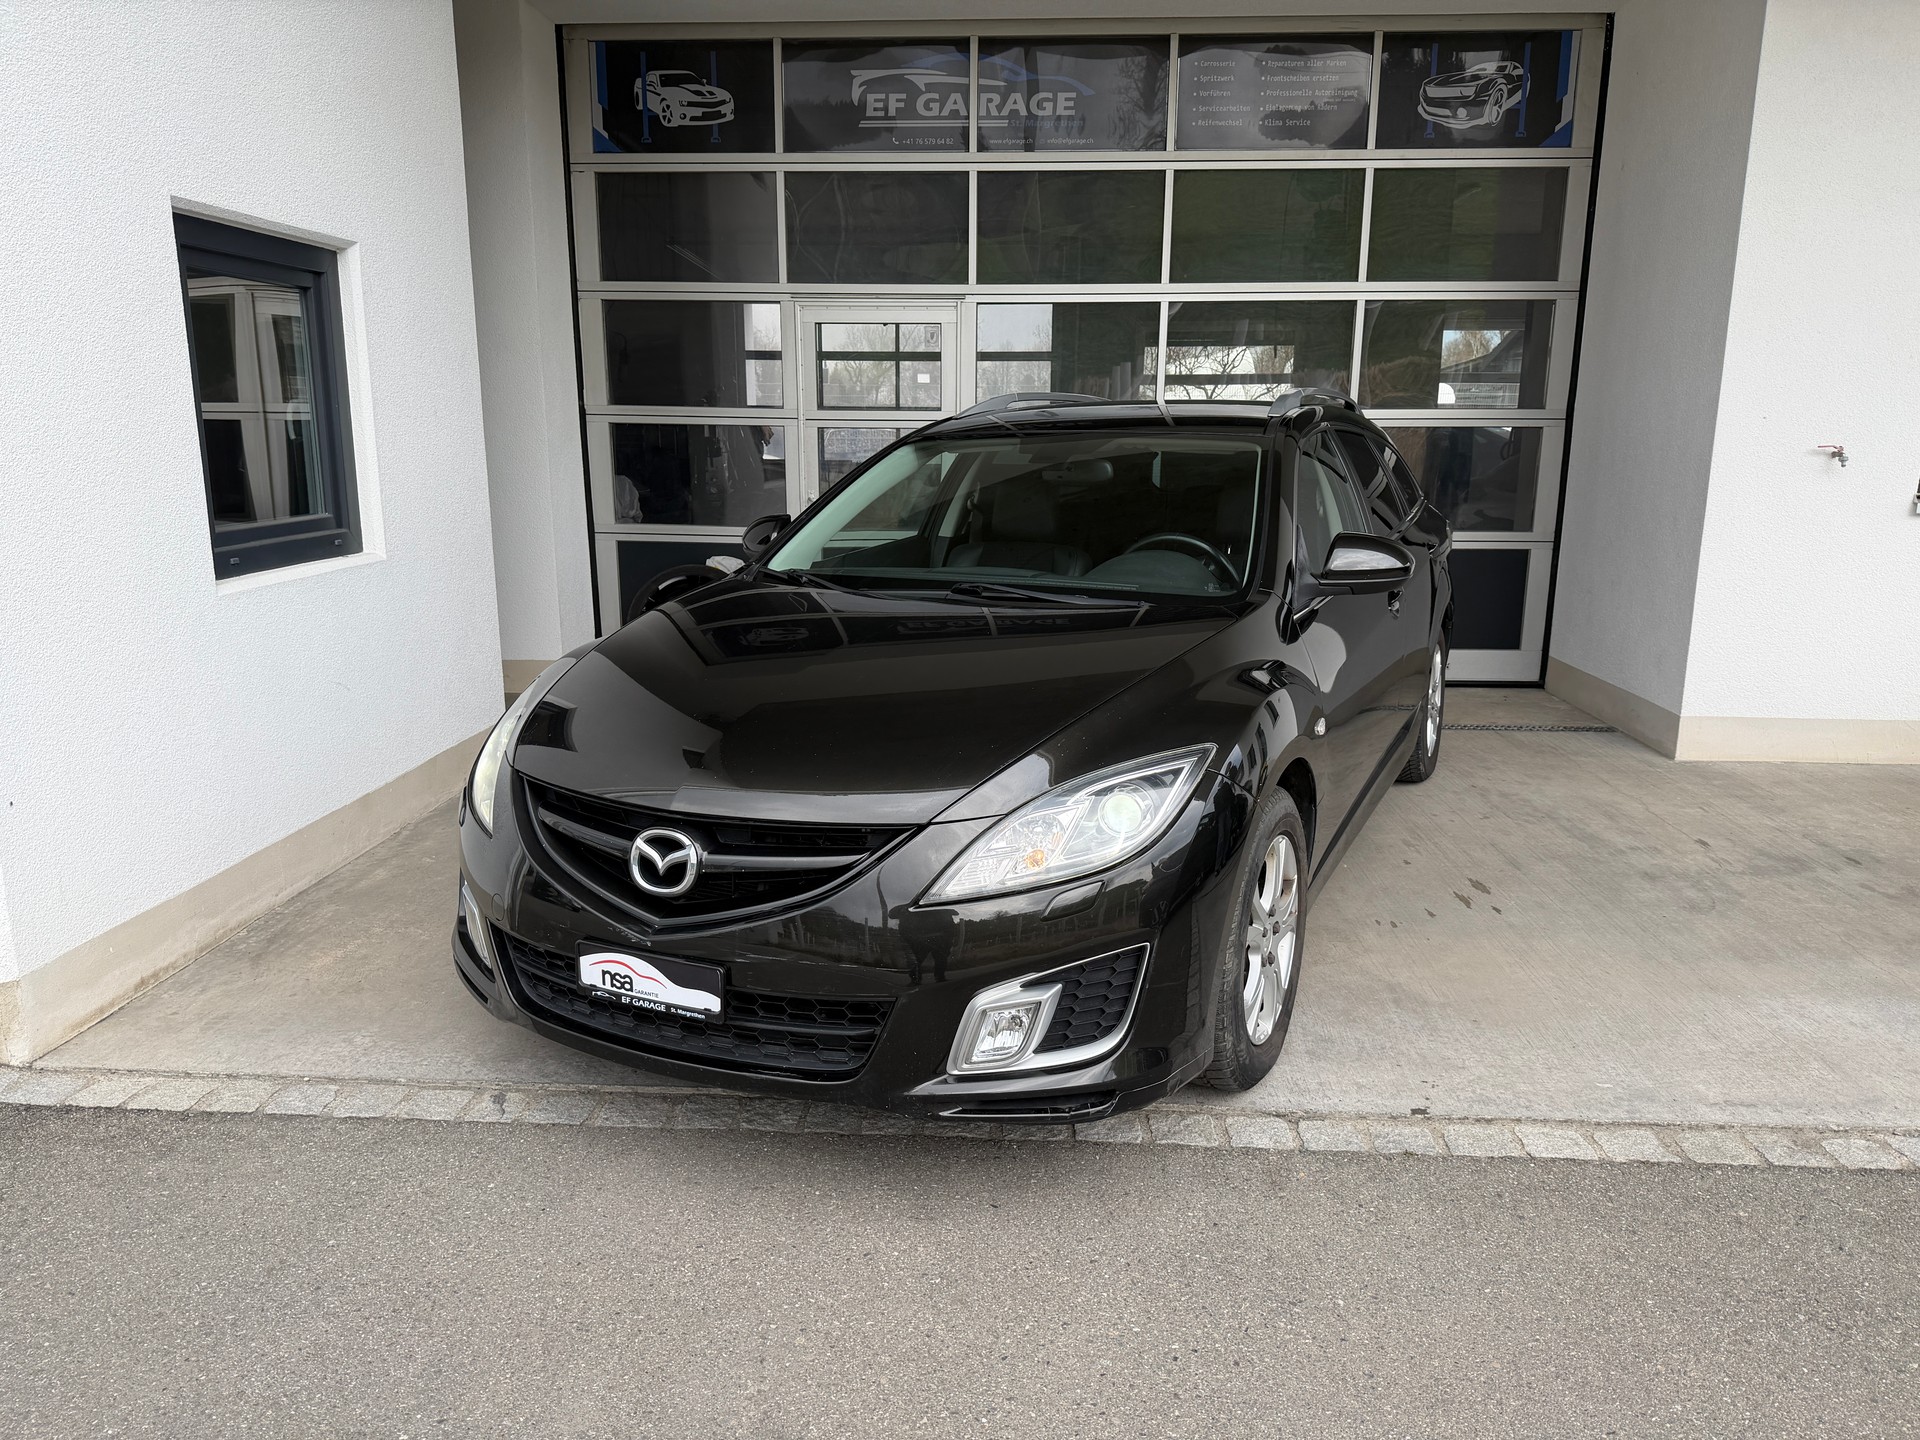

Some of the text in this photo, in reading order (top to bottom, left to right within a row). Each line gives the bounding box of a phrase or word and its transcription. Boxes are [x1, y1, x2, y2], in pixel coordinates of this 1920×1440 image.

[1267, 60, 1305, 68] Reparaturen
[1199, 75, 1235, 83] Spritzwerk
[1266, 89, 1358, 97] Professionelle Autoreinigung
[865, 91, 1077, 117] EF GARAGE
[1265, 104, 1302, 112] Einlagerung
[1047, 137, 1094, 145] info@efgarage.ch
[601, 969, 634, 993] nsa
[634, 988, 660, 998] GARANTIE
[621, 996, 631, 1004] EF
[632, 998, 666, 1012] GARAGE
[677, 1008, 706, 1019] Margrethen
